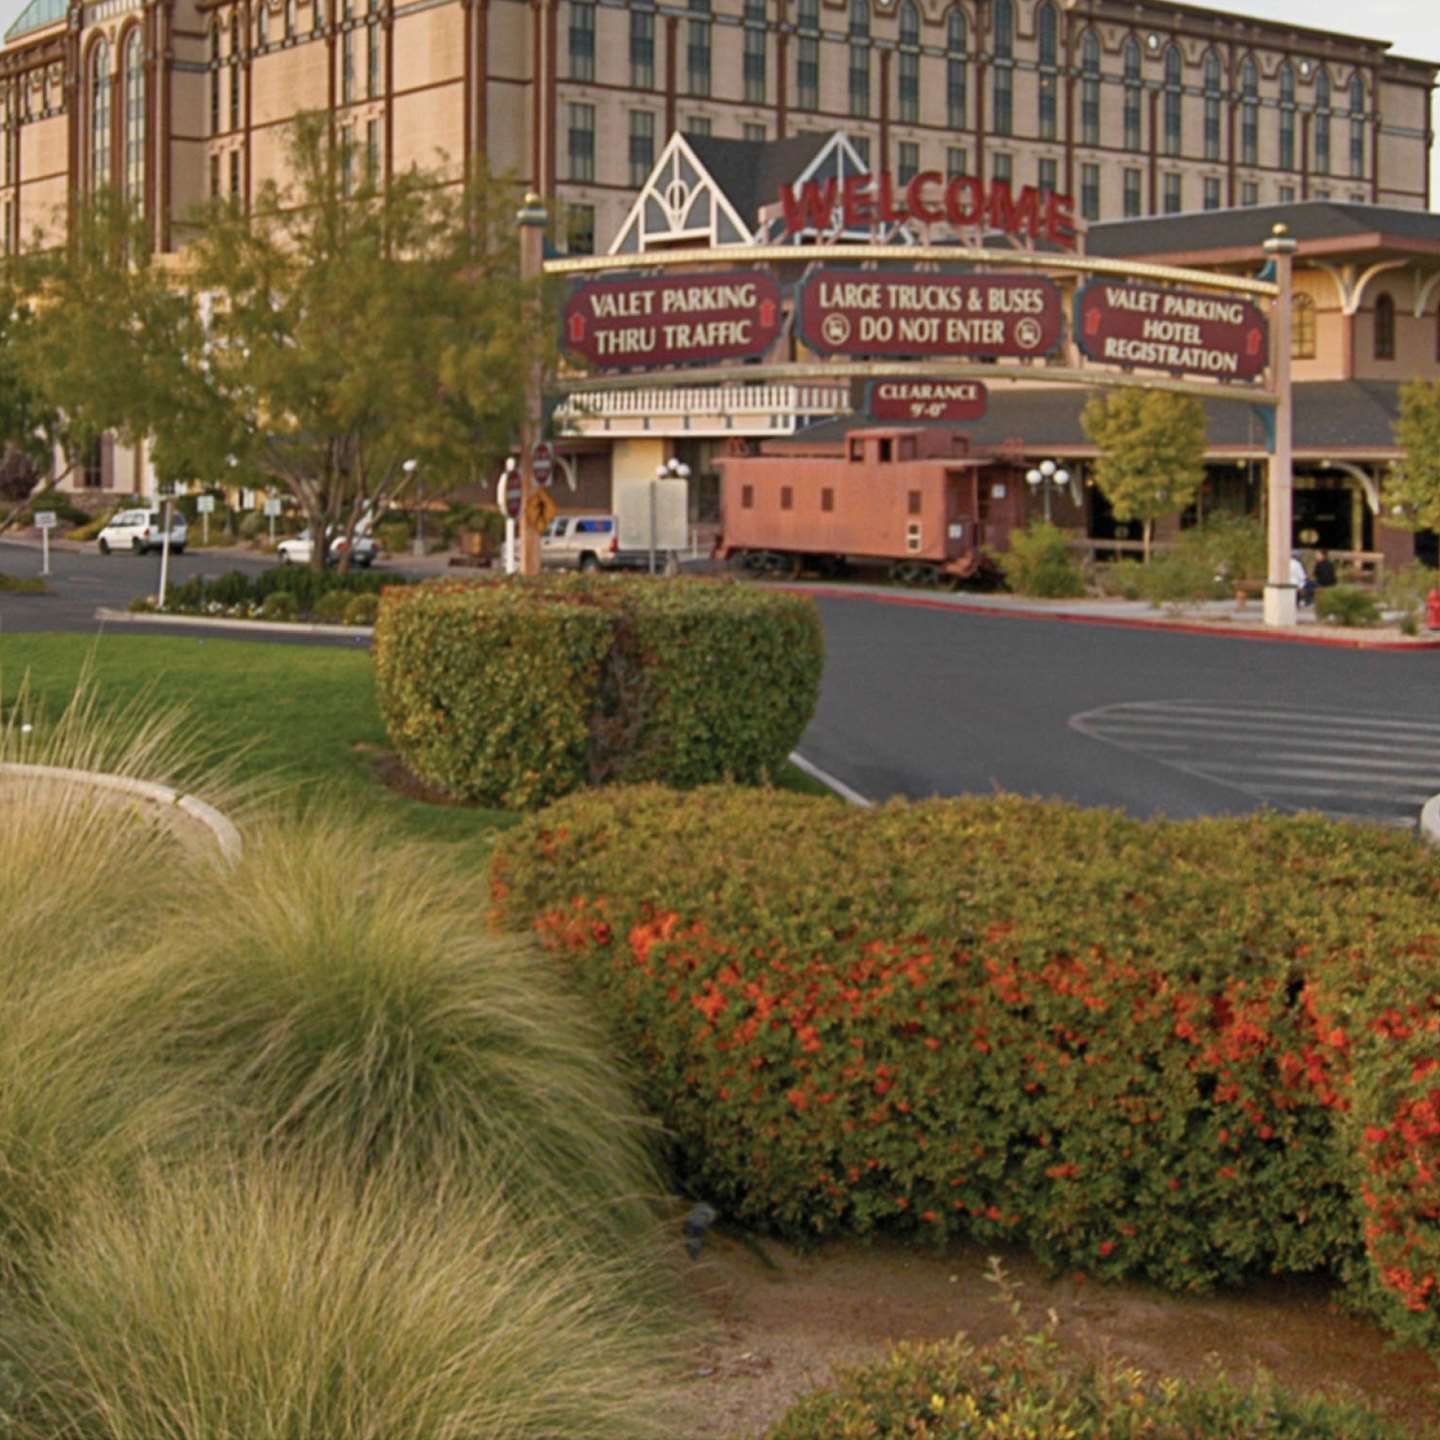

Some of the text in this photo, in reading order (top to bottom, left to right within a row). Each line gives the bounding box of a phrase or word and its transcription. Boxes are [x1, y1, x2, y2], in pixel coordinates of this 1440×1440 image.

[778, 169, 1078, 250] WELCOME
[590, 283, 756, 318] VALET PARKING
[819, 282, 1044, 314] LARGE TRUCKS & BUSES
[1105, 286, 1244, 325] VALET PARKING
[594, 319, 751, 355] THRU TRAFFIC
[859, 315, 1005, 344] DO NOT ENTER
[1142, 318, 1203, 346] HOTEL
[1103, 337, 1239, 373] REGISTRATION
[878, 383, 977, 400] CLEARANCE
